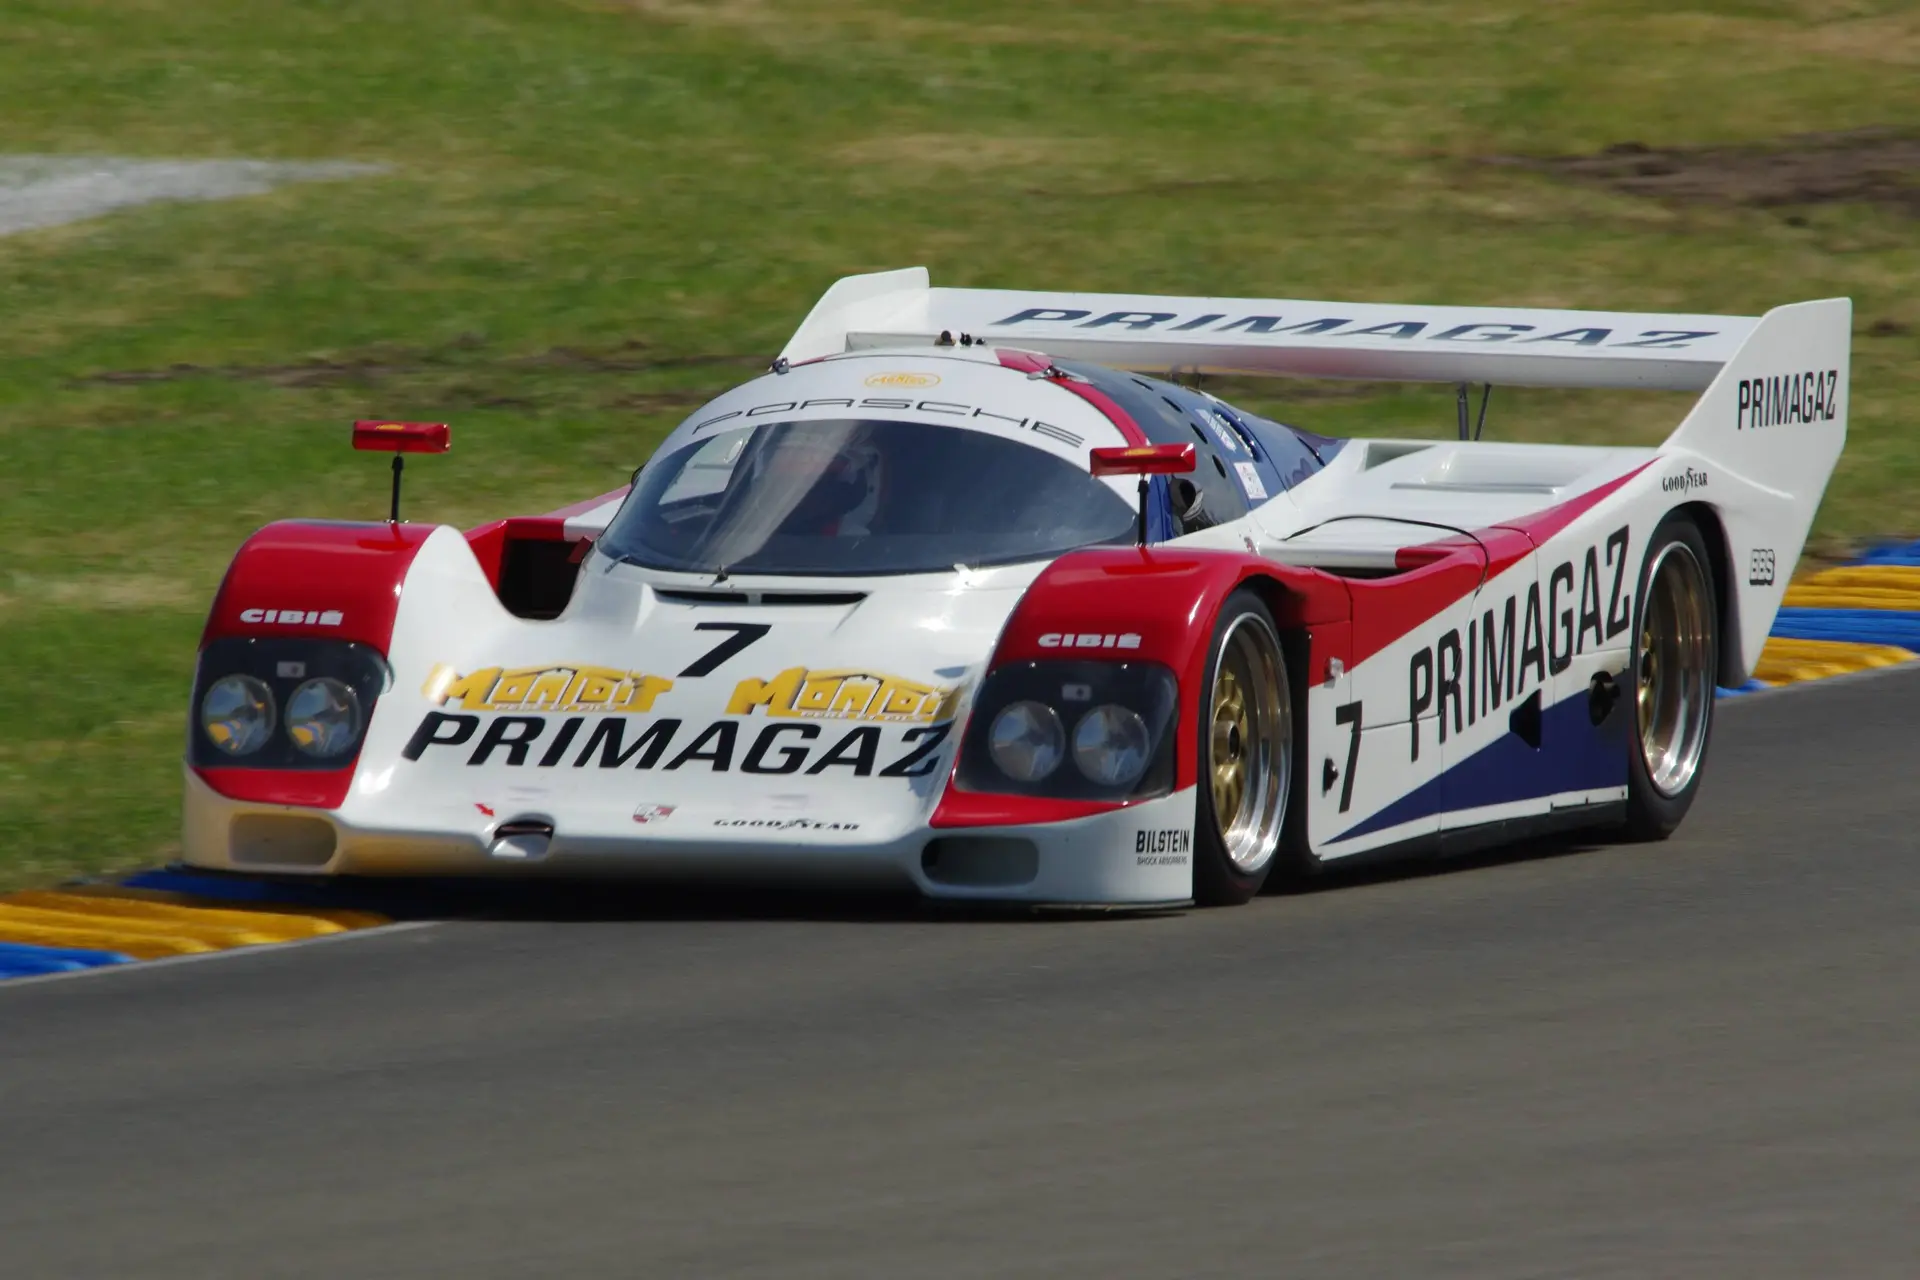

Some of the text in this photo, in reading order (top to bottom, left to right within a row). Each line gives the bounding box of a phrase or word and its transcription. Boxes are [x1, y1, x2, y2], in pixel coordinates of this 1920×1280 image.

[989, 308, 1720, 349] PRIMAGAZ
[692, 398, 1086, 449] PORSCHE
[1737, 370, 1839, 430] PRIMAGAZ
[1749, 549, 1775, 586] BBS
[677, 622, 772, 677] 7
[1410, 524, 1631, 763] PRIMAGAZ
[401, 711, 957, 777] PRIMAGAZ
[1336, 701, 1362, 813] 7
[1136, 830, 1190, 853] BILSTEIN
